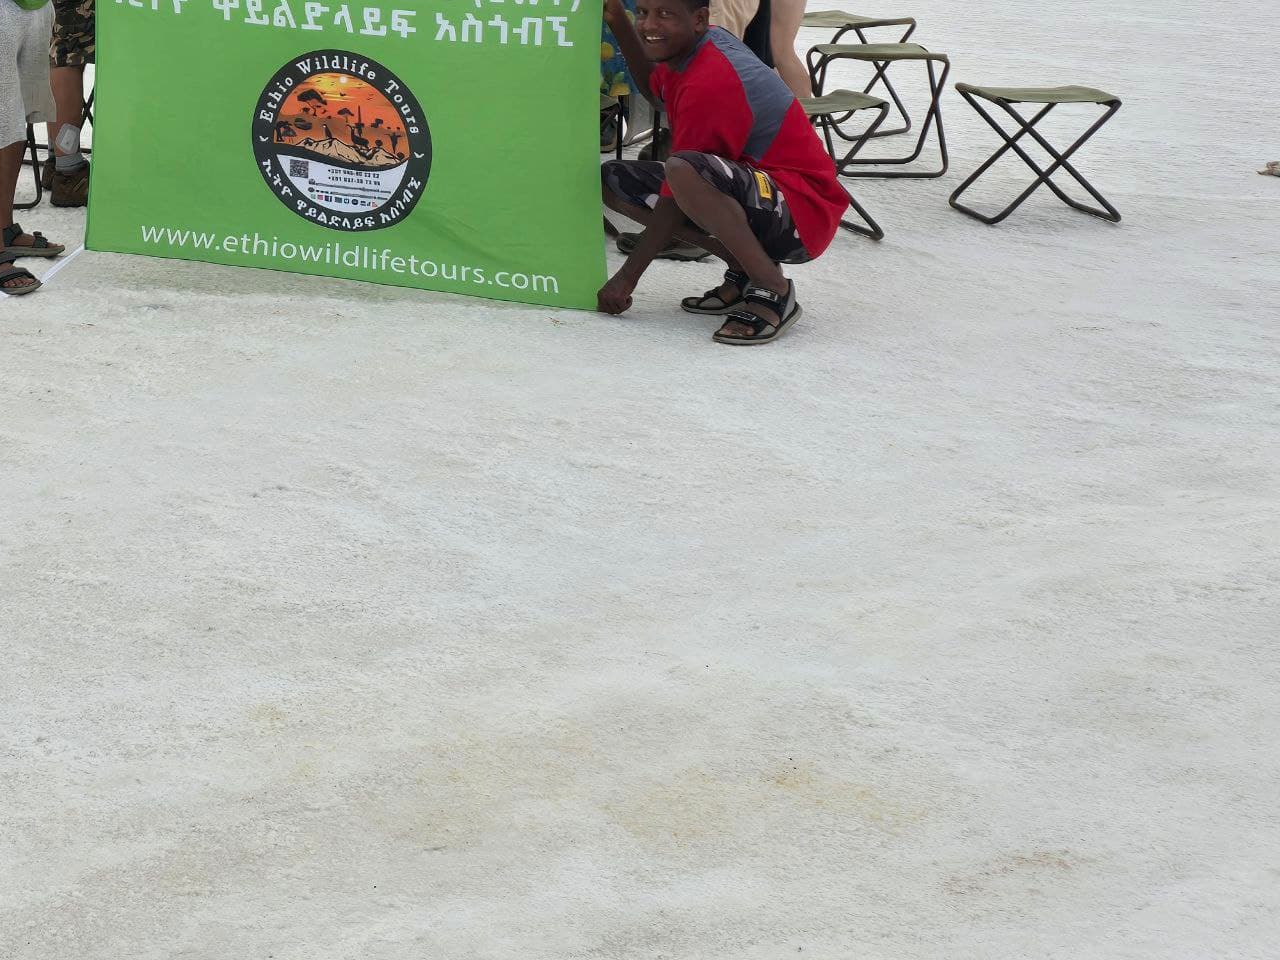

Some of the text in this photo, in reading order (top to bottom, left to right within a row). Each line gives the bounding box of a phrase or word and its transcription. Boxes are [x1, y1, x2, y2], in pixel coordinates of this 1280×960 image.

[259, 55, 419, 134] Ethio Wildlife Tours
[140, 224, 560, 294] www.ethiowildlifetours.com
